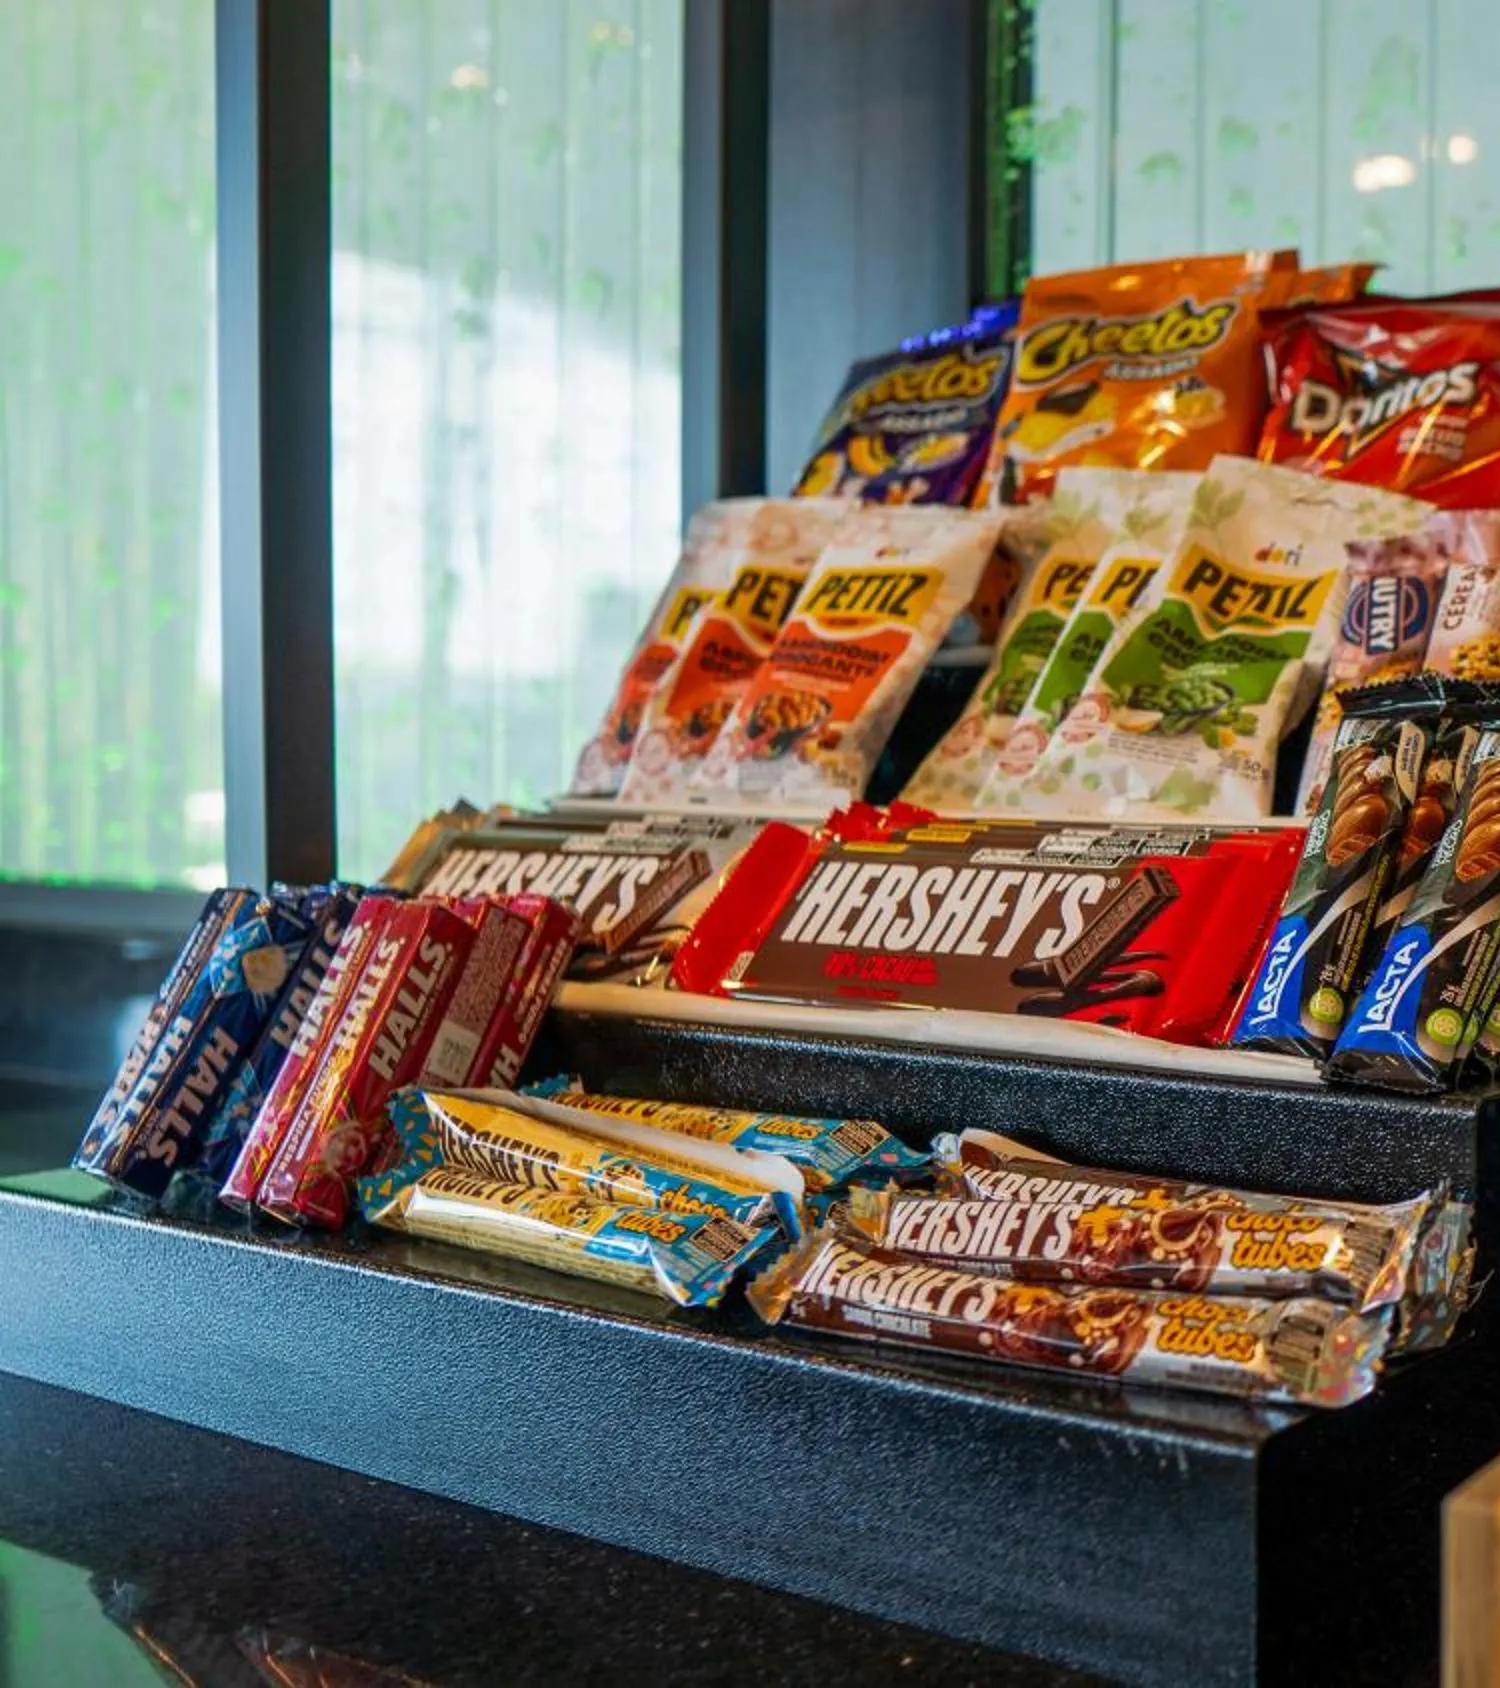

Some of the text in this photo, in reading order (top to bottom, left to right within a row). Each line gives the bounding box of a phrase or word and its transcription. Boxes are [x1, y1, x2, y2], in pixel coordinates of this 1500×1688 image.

[1017, 300, 1237, 383] Cheetos
[851, 354, 1001, 415] eetos
[1291, 362, 1480, 440] Doritos
[805, 573, 928, 617] PETTIZ
[782, 861, 1102, 959] HERSHEY'S
[290, 921, 369, 1058] HALLS
[333, 936, 404, 1052] HALLS
[368, 936, 450, 1081] HALLS
[1250, 928, 1298, 1026] LACTA
[1358, 940, 1419, 1033] LACTA
[147, 1026, 239, 1167] HALLS
[884, 1199, 1083, 1260] HERSHEY'S
[1229, 1227, 1328, 1271] tubes
[798, 1240, 997, 1322] HERSHEY'S
[1156, 1314, 1260, 1363] tubes
